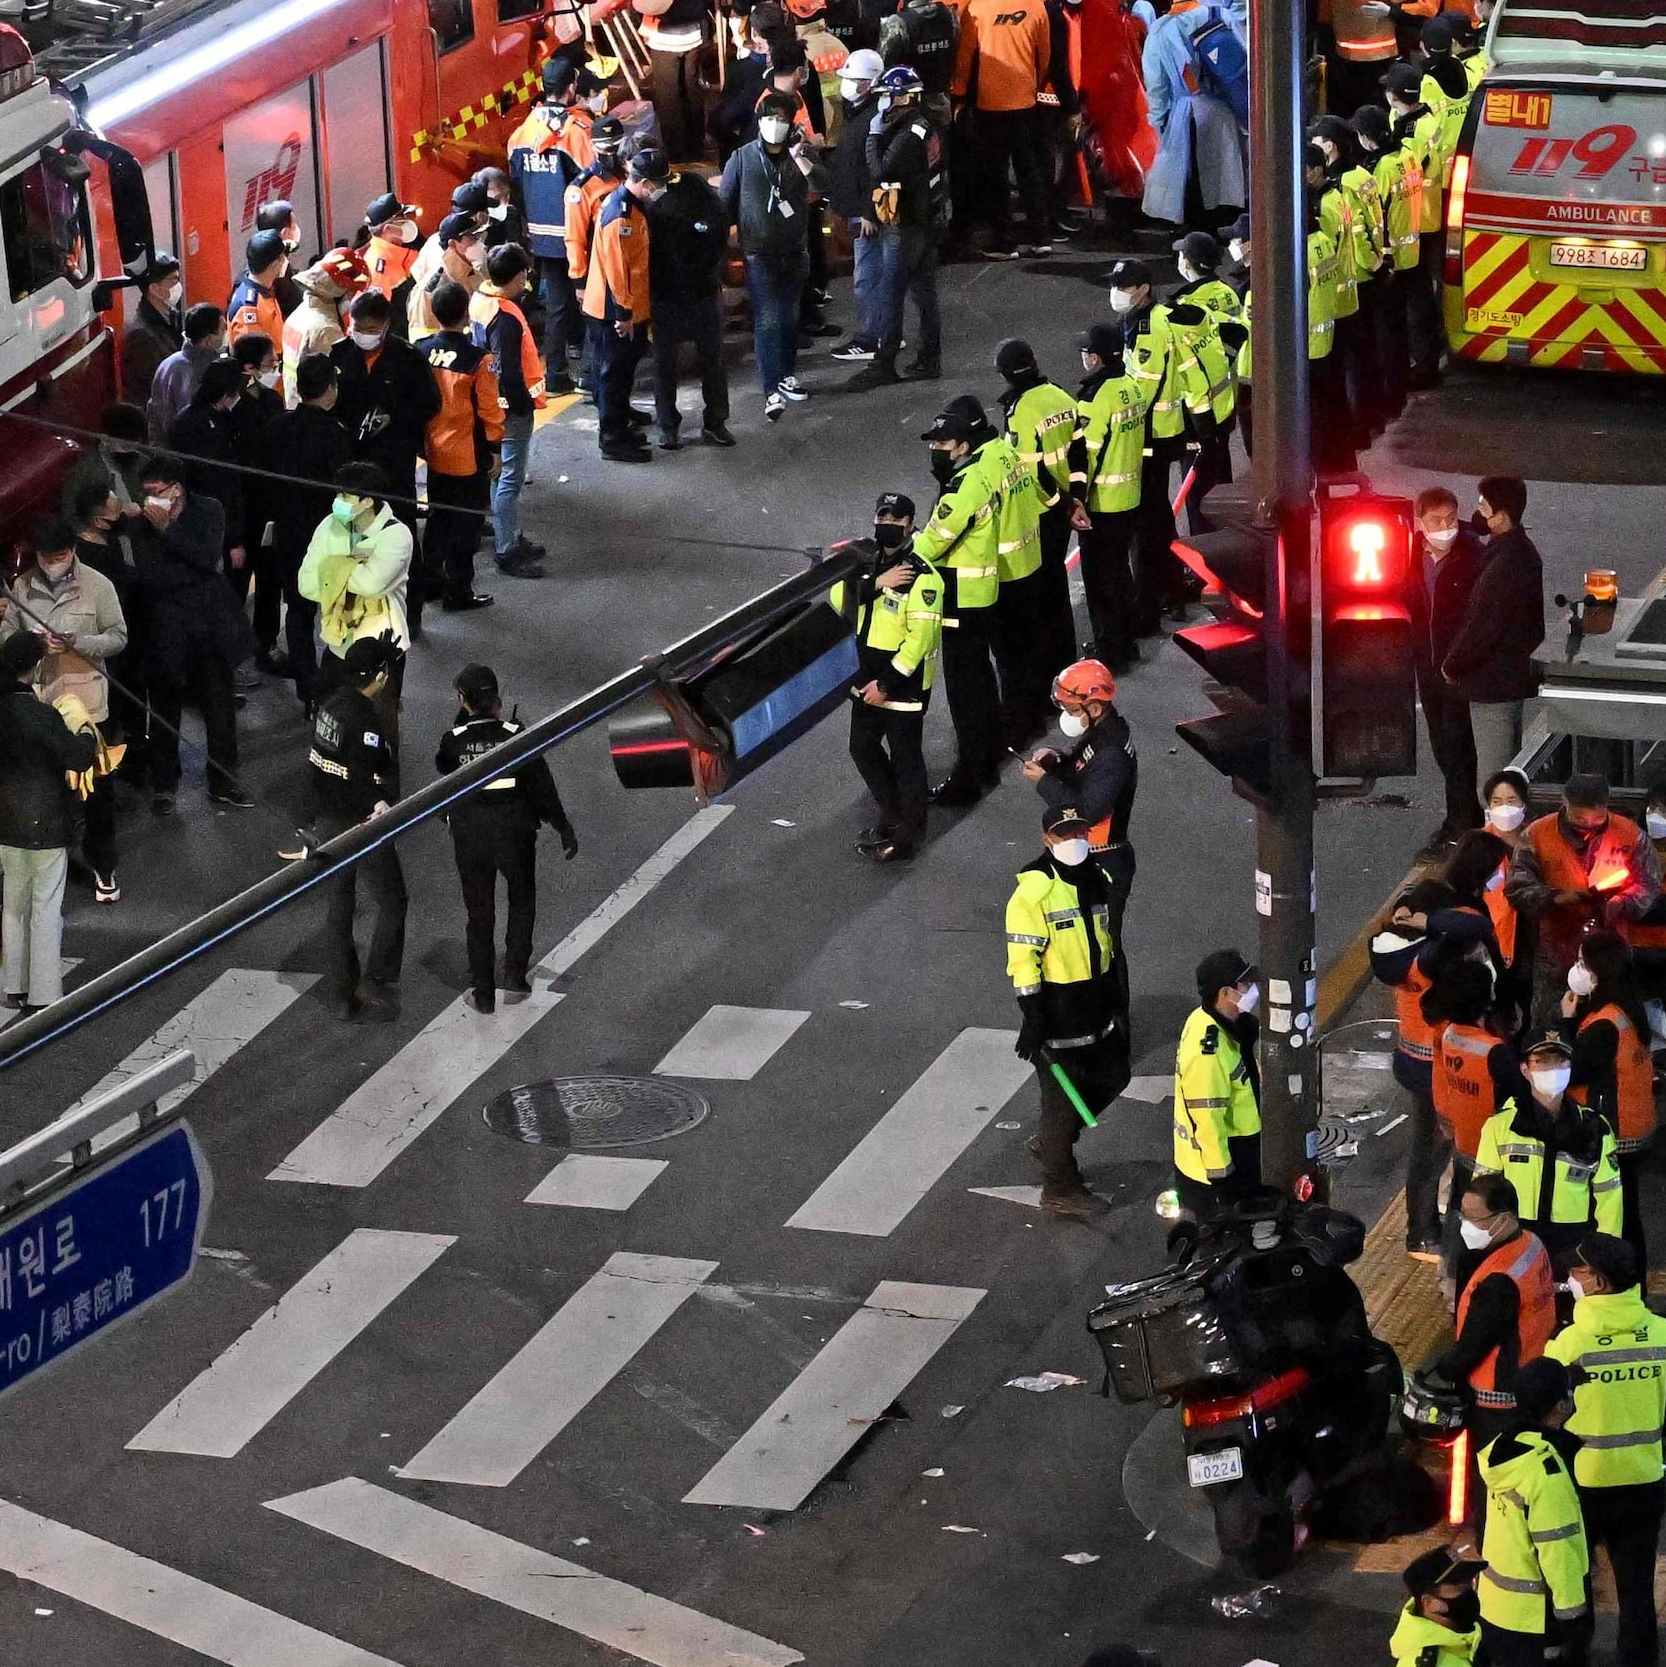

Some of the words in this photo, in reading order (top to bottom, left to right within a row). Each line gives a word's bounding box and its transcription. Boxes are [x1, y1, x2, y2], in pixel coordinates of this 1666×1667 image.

[994, 10, 1027, 26] 119
[1485, 93, 1550, 127] 별내1
[1507, 124, 1637, 180] 119
[240, 131, 301, 231] 119
[1547, 206, 1651, 225] AMBULANCE
[140, 1178, 186, 1248] 177
[49, 1264, 135, 1346] 梨泰院路
[1588, 1364, 1661, 1384] POLICE
